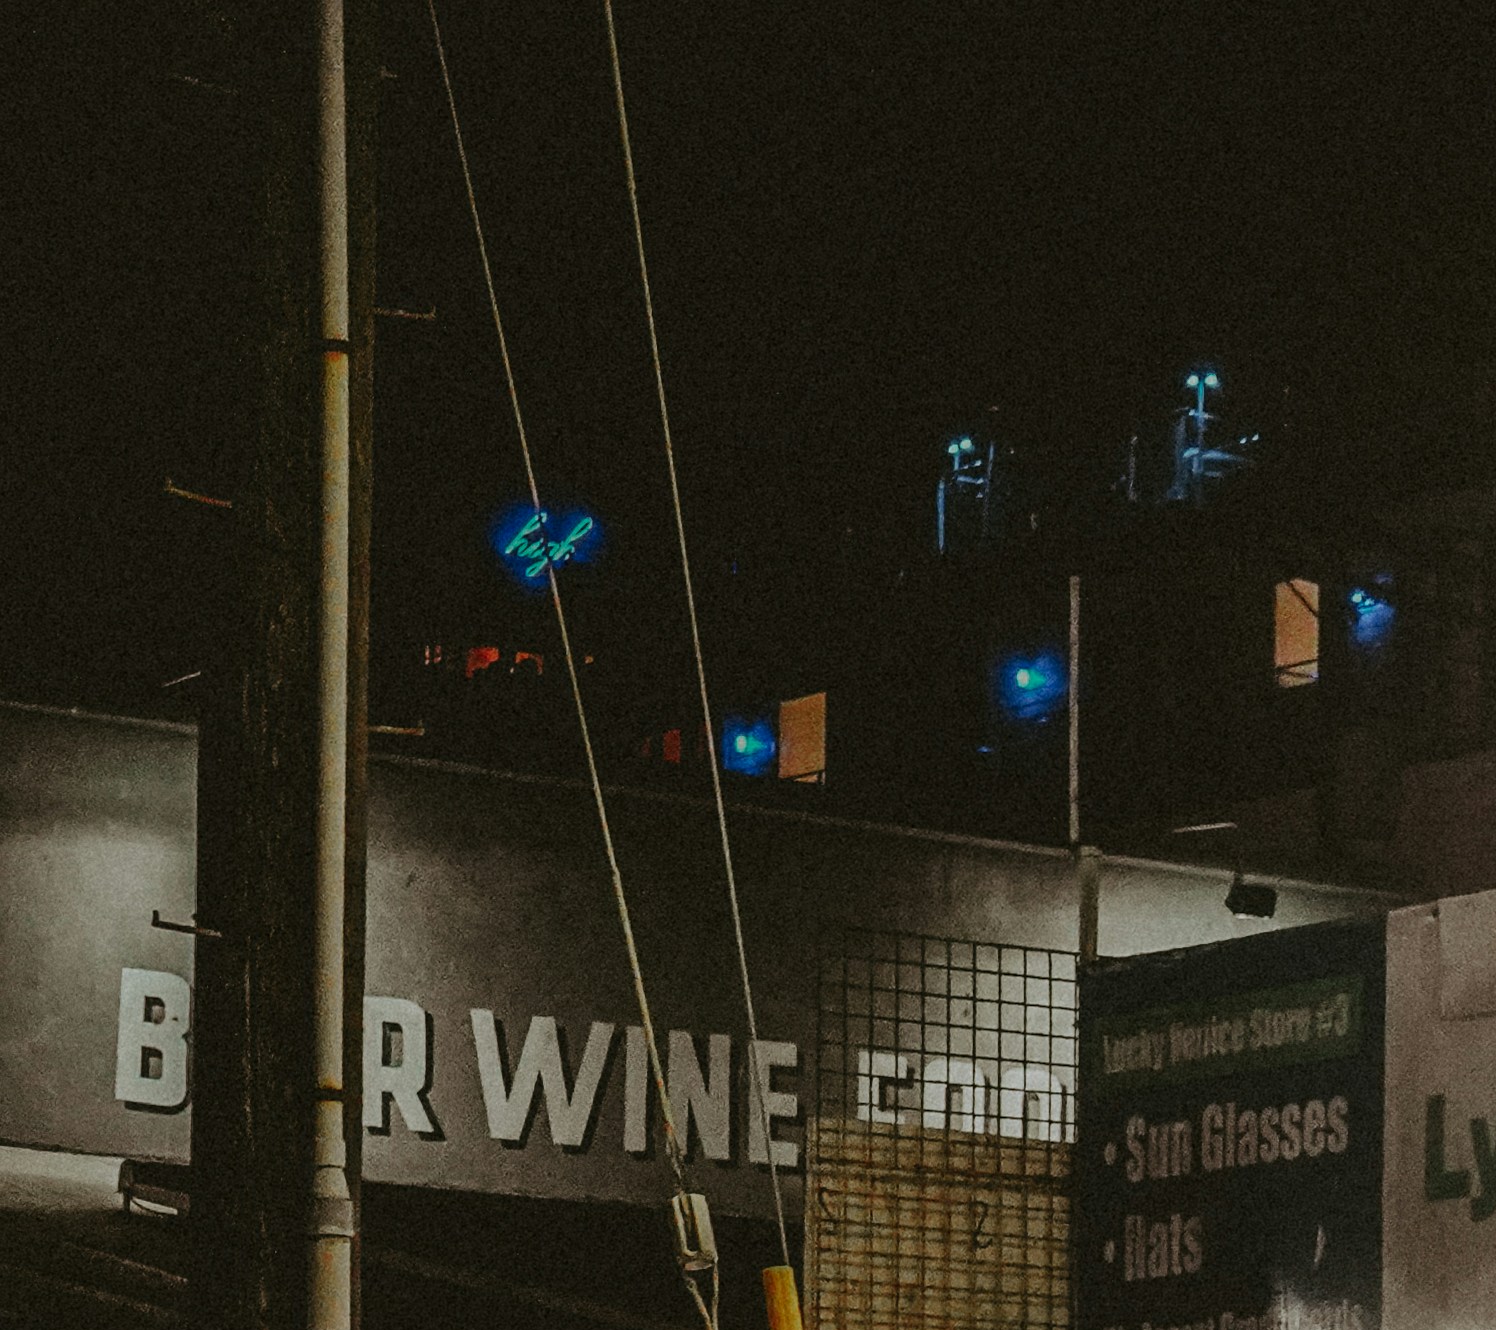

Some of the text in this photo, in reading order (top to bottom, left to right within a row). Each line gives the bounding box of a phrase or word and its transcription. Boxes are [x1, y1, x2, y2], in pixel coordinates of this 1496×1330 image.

[115, 967, 801, 1167] BR WINE
[1125, 1095, 1348, 1183] Sun Glasses
[1124, 1213, 1202, 1282] Hats
